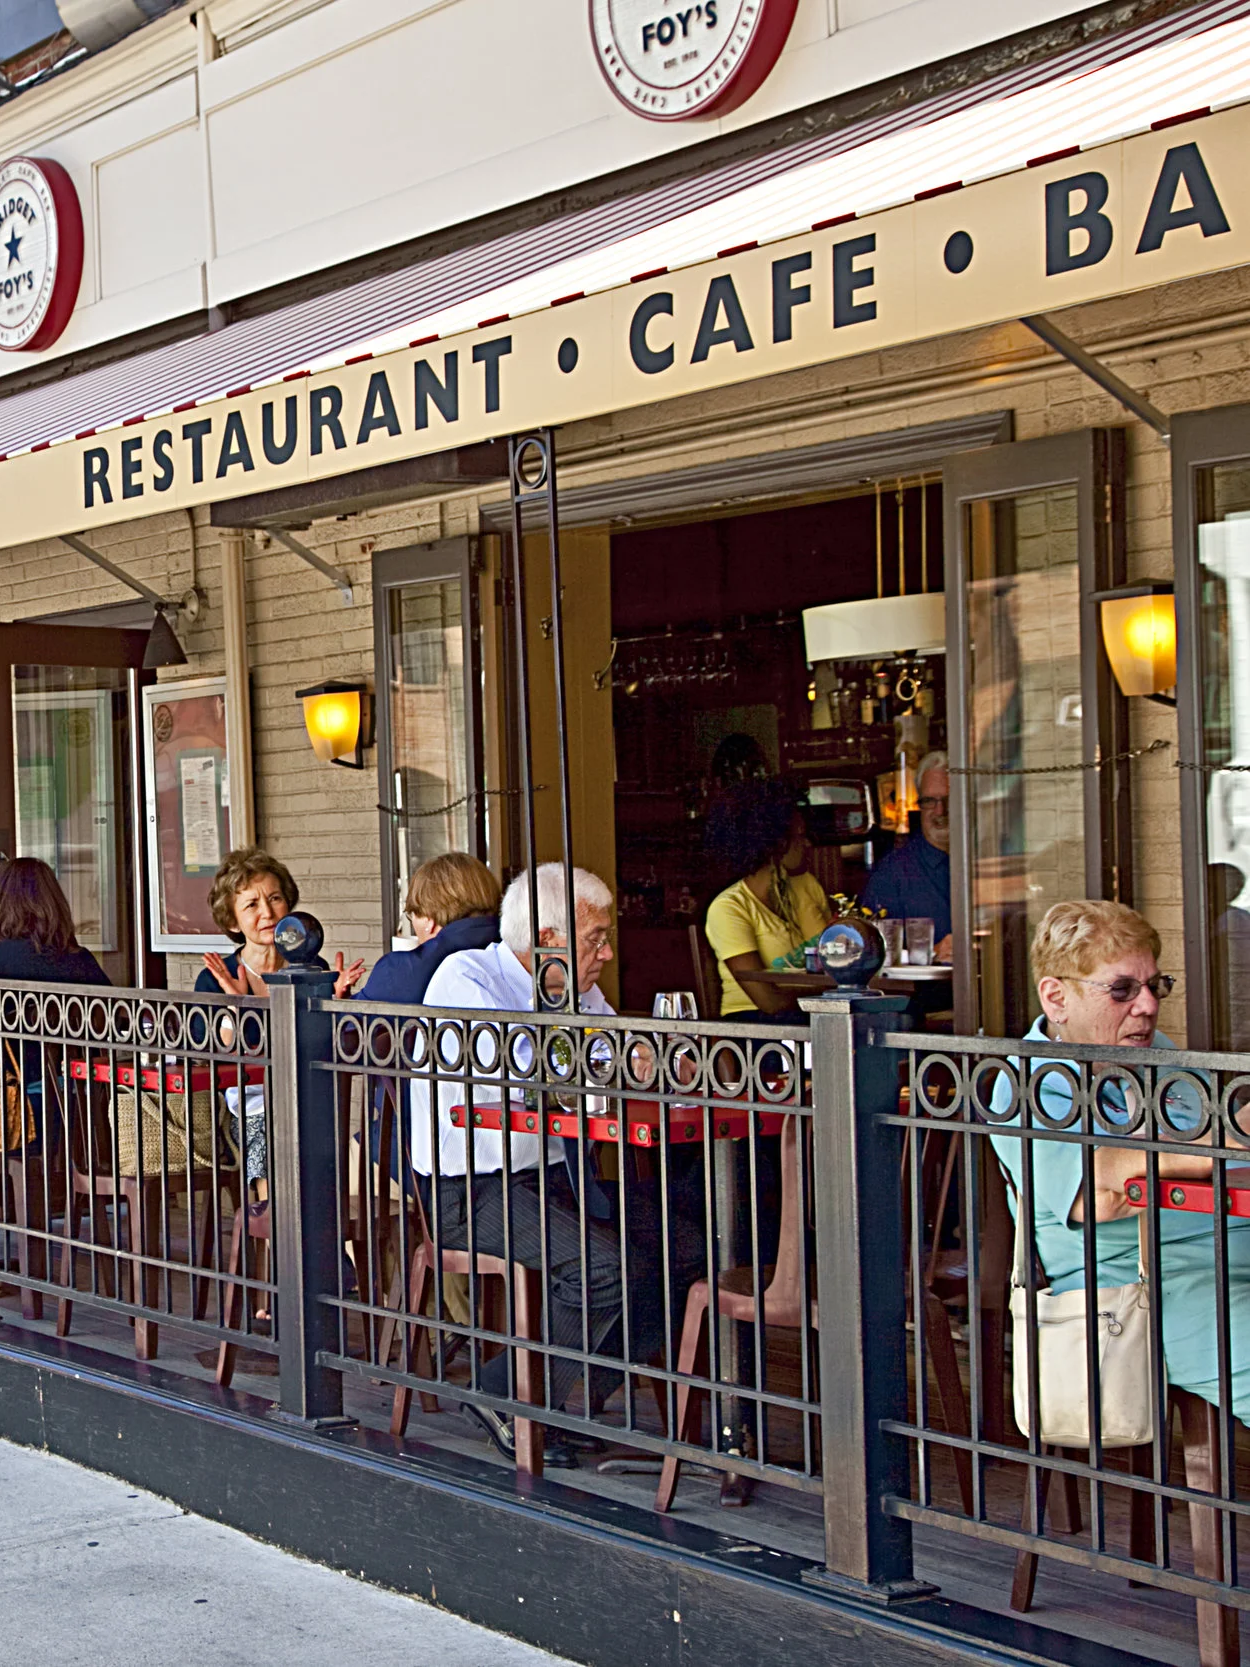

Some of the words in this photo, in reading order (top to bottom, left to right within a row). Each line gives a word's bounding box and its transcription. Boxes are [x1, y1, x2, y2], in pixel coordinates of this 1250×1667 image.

[641, 0, 718, 53] FOY'S
[83, 335, 512, 508] RESTAURANT
[629, 233, 877, 375] CAFE
